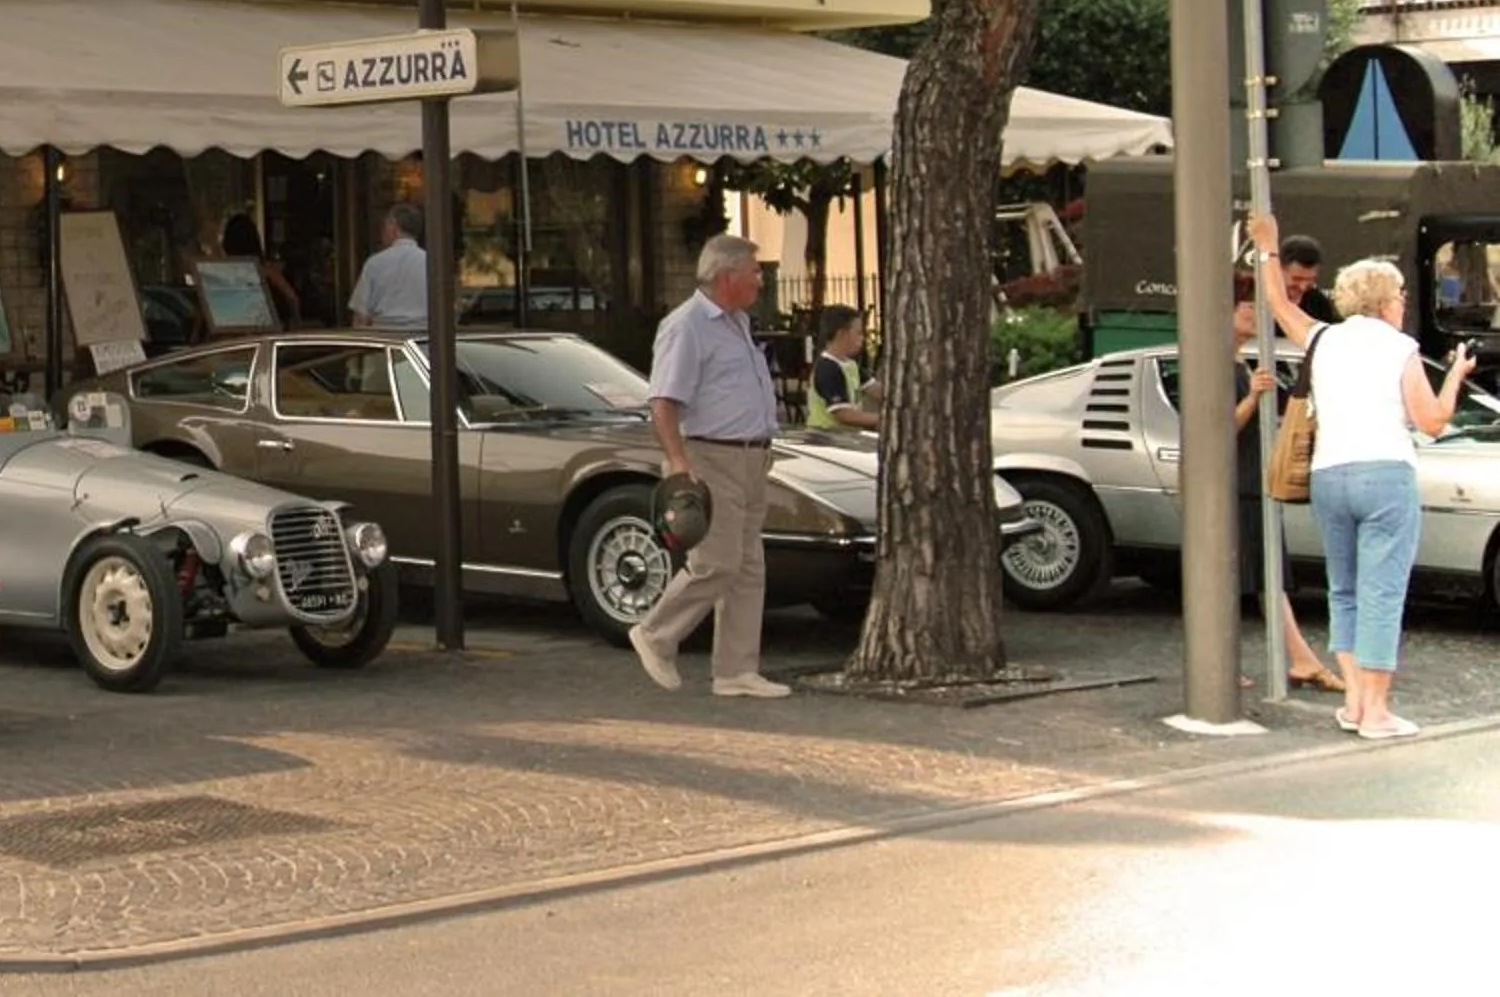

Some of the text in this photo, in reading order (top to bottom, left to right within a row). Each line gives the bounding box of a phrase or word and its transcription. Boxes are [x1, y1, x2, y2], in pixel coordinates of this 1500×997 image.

[344, 49, 467, 89] AZZURRA
[566, 120, 769, 151] HOTEL AZZURRA
